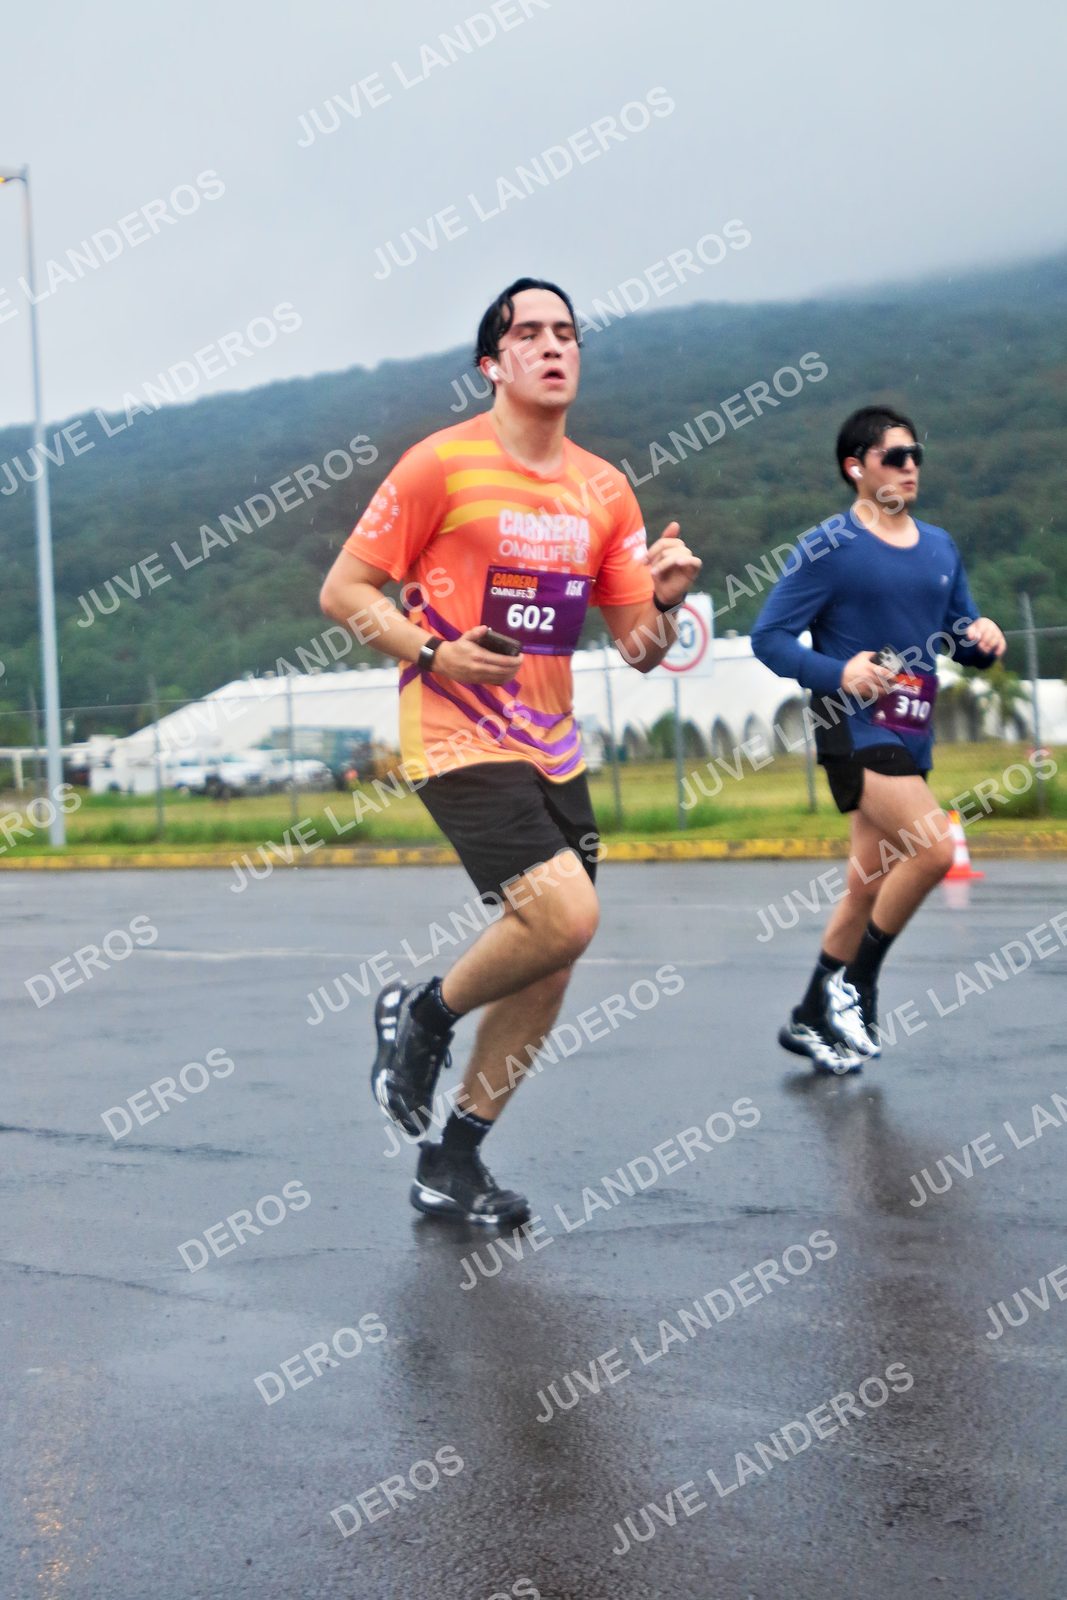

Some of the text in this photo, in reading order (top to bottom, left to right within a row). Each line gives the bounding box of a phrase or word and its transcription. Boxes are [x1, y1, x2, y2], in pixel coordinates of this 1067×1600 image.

[499, 540, 571, 562] OMNILIFE
[492, 572, 538, 589] CARRERA
[491, 586, 526, 598] OMNILIFE
[507, 603, 556, 631] 602
[895, 694, 931, 719] 310
